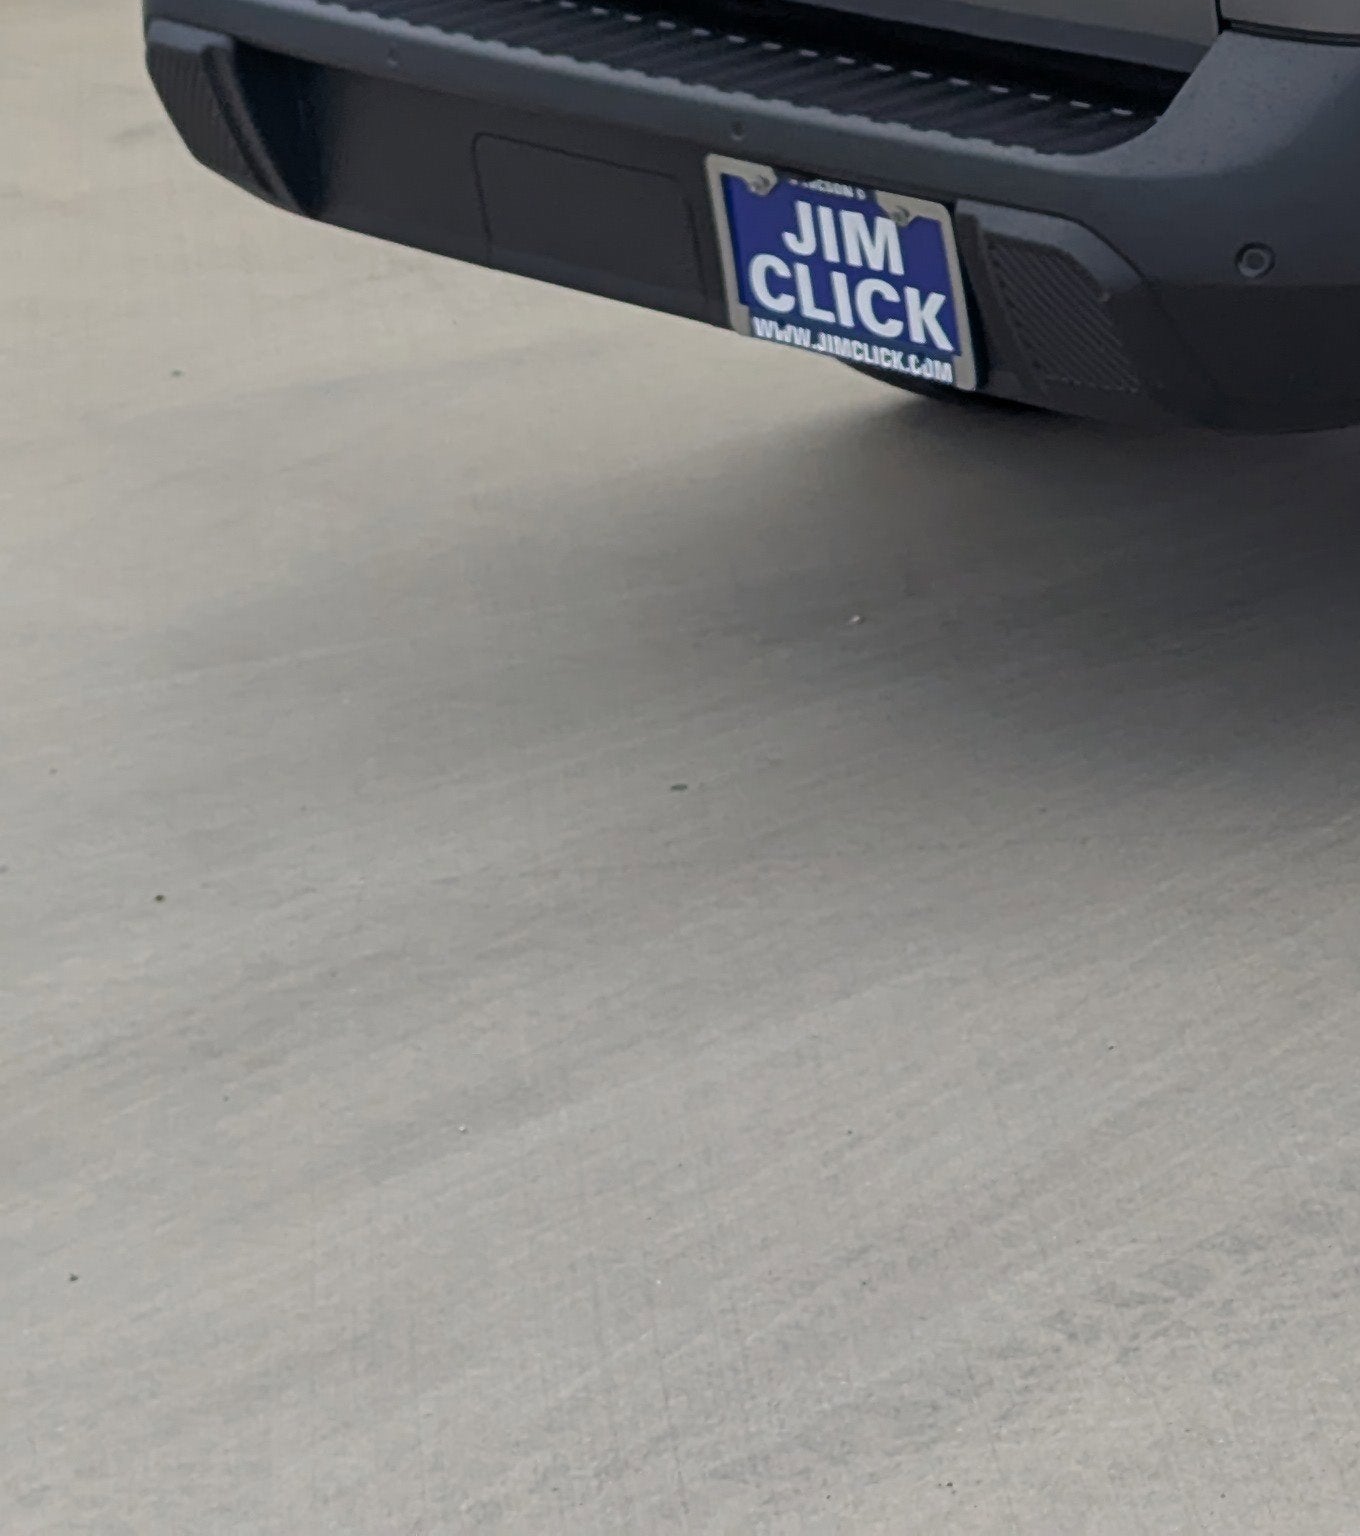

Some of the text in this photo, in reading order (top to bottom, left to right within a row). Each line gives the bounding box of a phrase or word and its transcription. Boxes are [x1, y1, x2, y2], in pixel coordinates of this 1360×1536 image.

[782, 200, 905, 276] JIM
[750, 253, 955, 352] CLICK
[752, 316, 954, 383] WWW.JIMCLICK.COM
